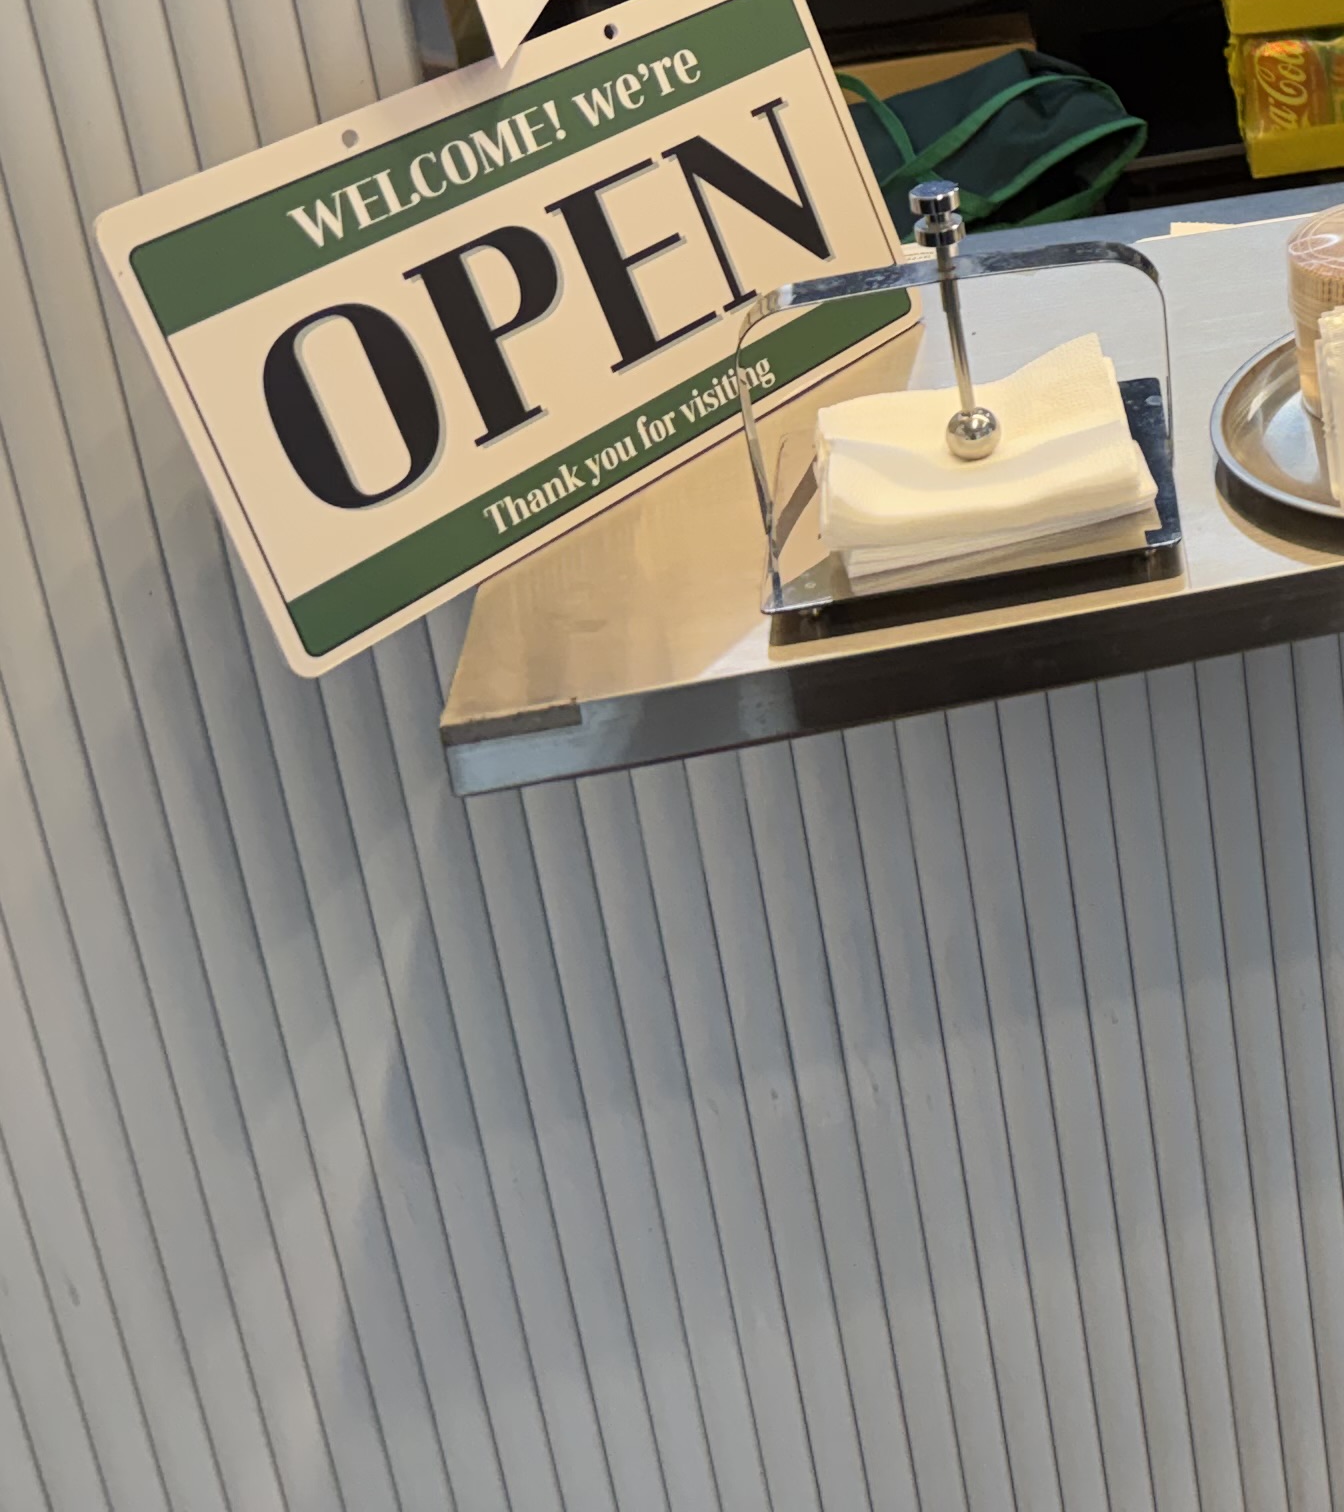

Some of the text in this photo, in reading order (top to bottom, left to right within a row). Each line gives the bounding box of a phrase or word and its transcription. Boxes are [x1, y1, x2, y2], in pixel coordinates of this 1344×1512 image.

[287, 96, 569, 252] WELCOME!
[262, 95, 835, 512] OPEN
[483, 463, 586, 535] Thank
[584, 436, 638, 486] you
[635, 410, 677, 451] for
